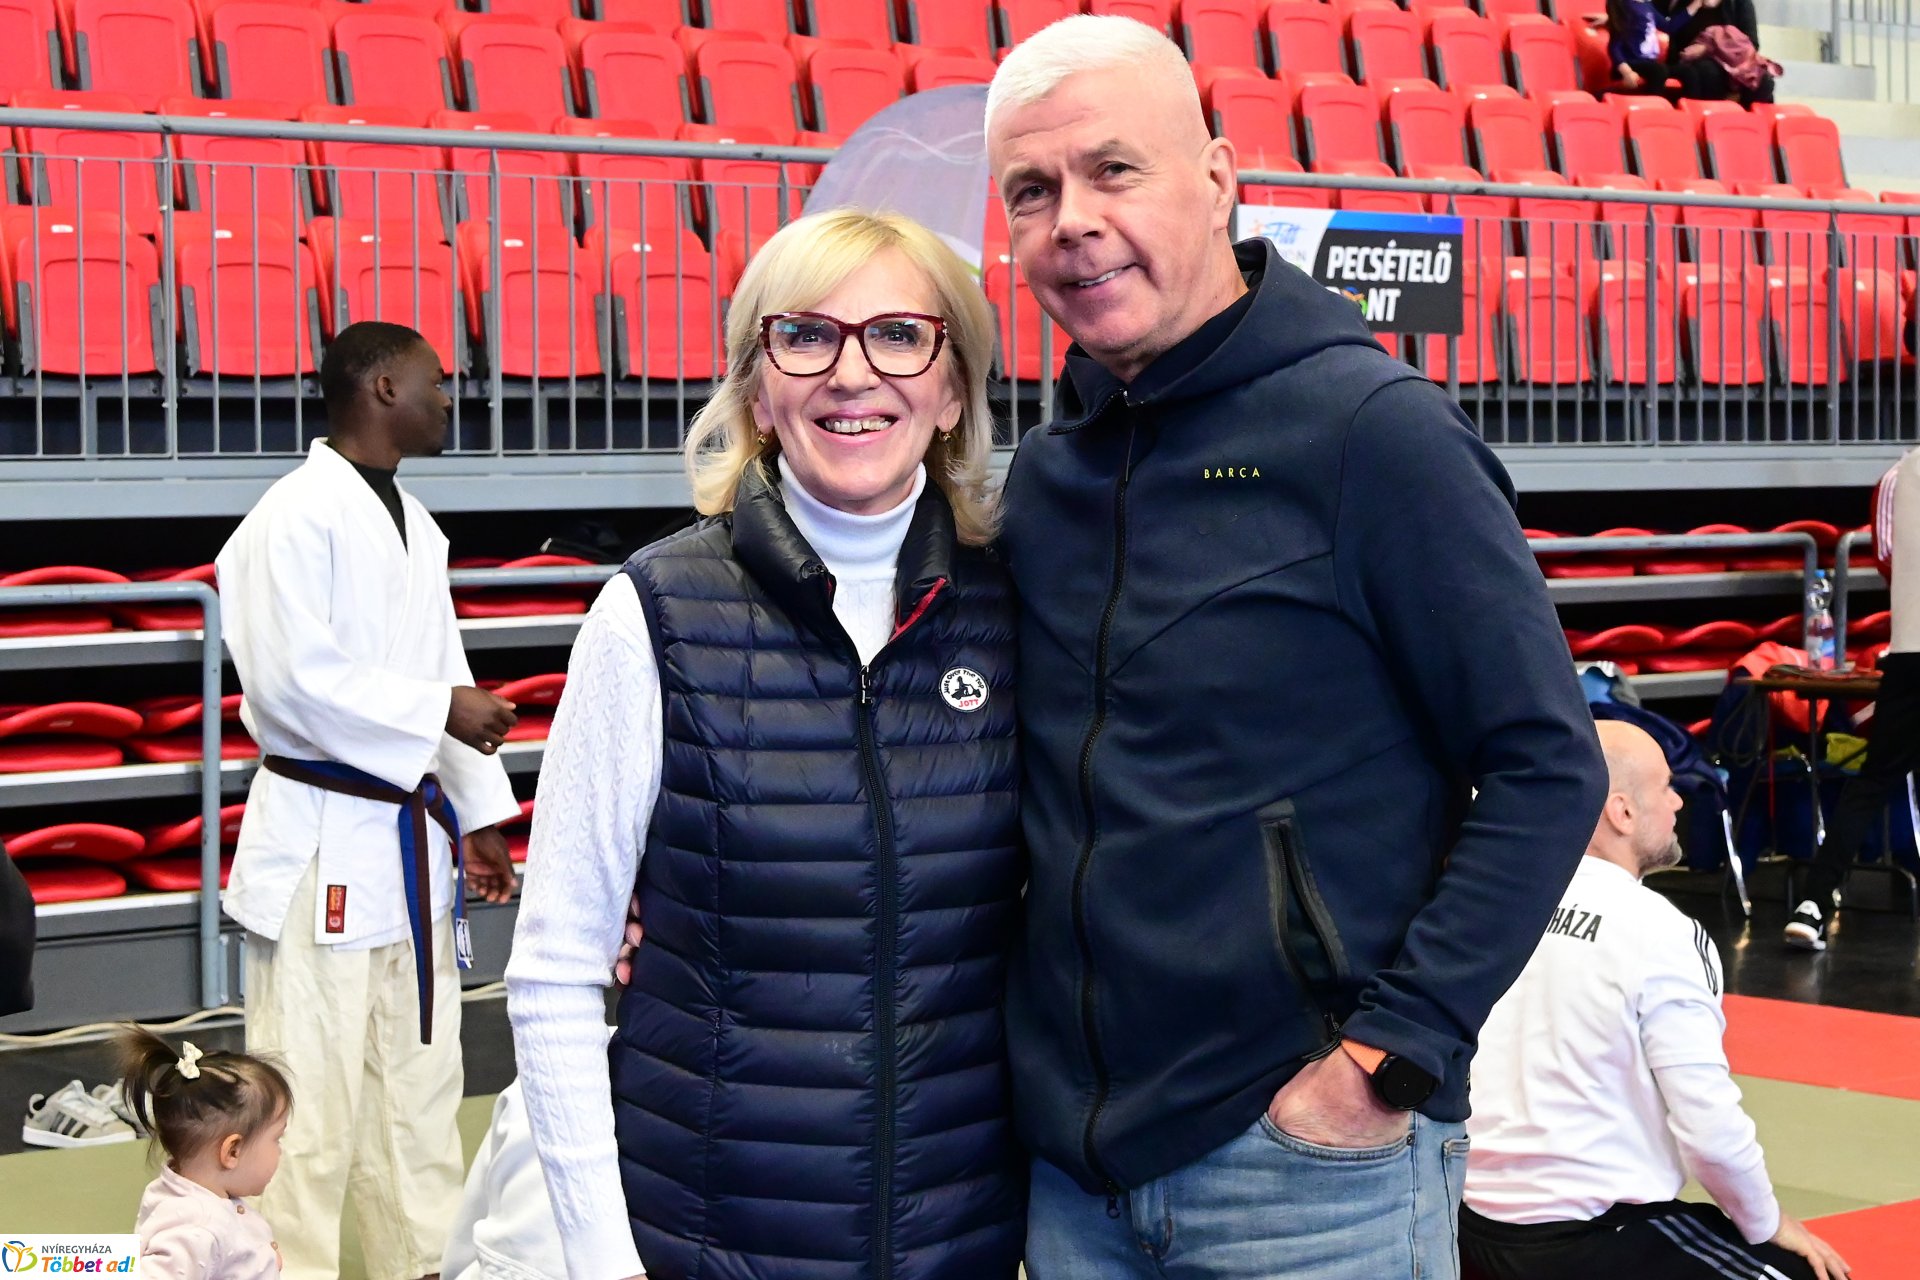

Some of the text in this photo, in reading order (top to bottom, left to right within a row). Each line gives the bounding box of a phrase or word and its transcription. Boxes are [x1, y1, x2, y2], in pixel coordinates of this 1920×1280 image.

[947, 670, 961, 679] Over
[976, 678, 985, 689] Top
[959, 699, 979, 707] JOTT
[1546, 903, 1602, 943] HÁZA
